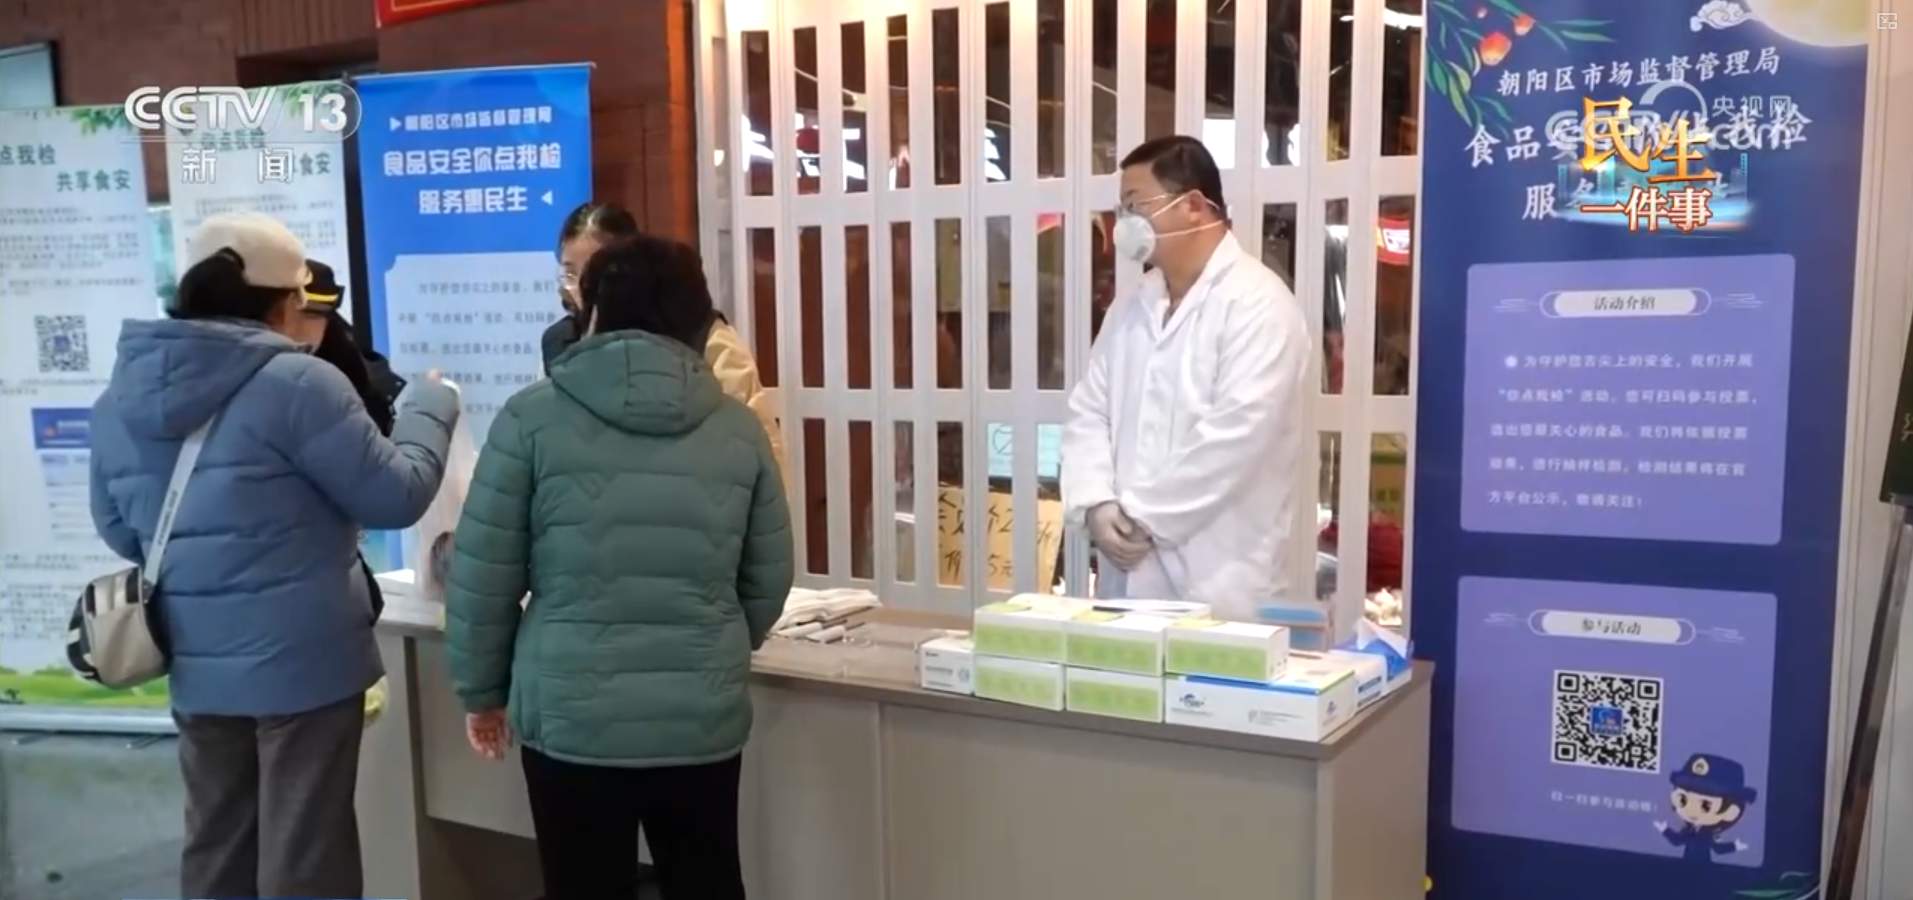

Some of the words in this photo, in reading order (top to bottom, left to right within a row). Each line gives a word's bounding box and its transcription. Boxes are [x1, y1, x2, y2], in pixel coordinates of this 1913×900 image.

[1496, 47, 1780, 97] 朝阳区市场监督管理局
[404, 105, 553, 132] 朝阳区市场监督管理局
[383, 143, 562, 177] 食品安全你点我检
[57, 169, 132, 193] 共享食安
[418, 186, 528, 215] 服务惠民生
[1593, 294, 1656, 311] 活动介绍
